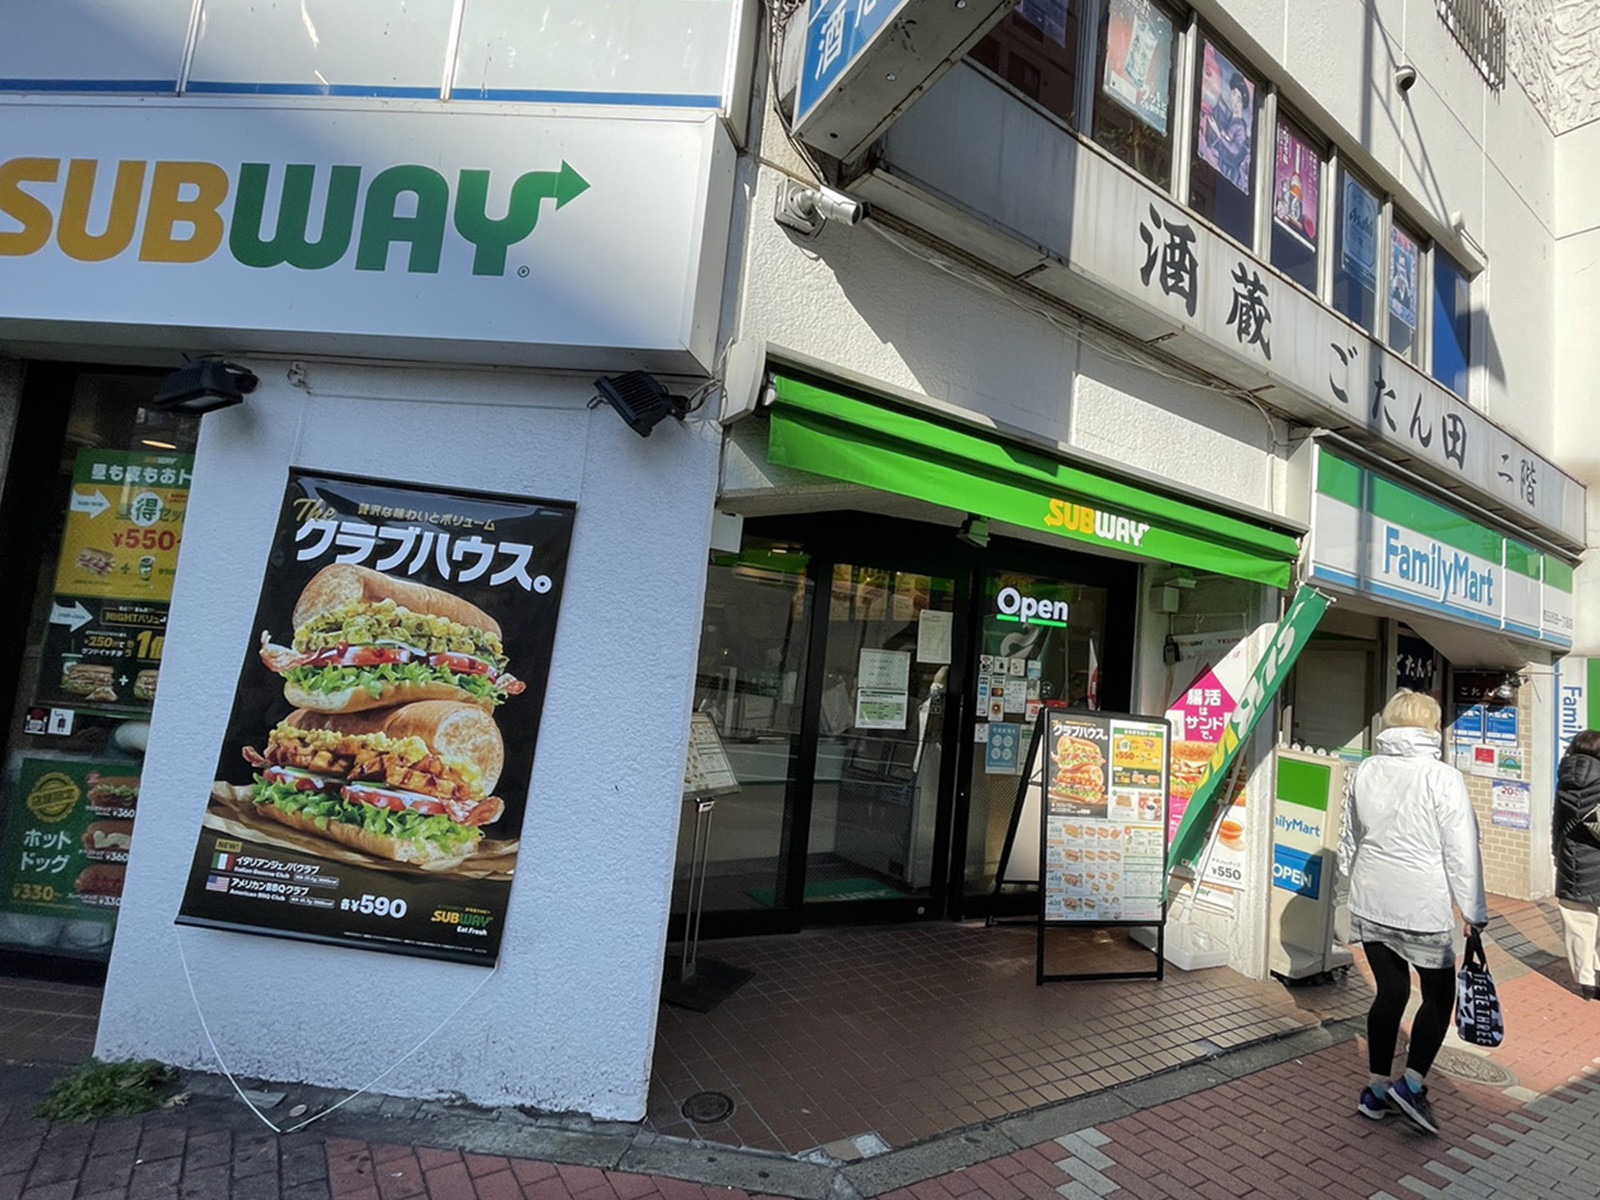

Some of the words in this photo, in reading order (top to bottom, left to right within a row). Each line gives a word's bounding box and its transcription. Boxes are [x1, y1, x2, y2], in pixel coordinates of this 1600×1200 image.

[0, 157, 591, 276] SUBWAY
[1139, 202, 1272, 361] 酒蔵
[1328, 341, 1468, 471] ごたん田
[1496, 453, 1537, 507] 二階
[293, 497, 337, 522] The
[357, 502, 496, 531] 贅沢な味わいとボリューム
[1044, 498, 1150, 547] SUBWAY
[294, 517, 553, 594] クラブハウス。
[1383, 525, 1494, 606] FamilyMart
[997, 587, 1069, 622] Open
[1185, 715, 1224, 731] サンド
[1560, 686, 1582, 749] Family
[23, 828, 72, 850] ホット
[1275, 814, 1320, 838] ilyMart
[20, 851, 71, 874] ドッグ
[1211, 865, 1241, 881] ¥550
[1272, 862, 1313, 888] OPEN
[431, 910, 494, 927] SUBWAY
[456, 925, 469, 934] Eat
